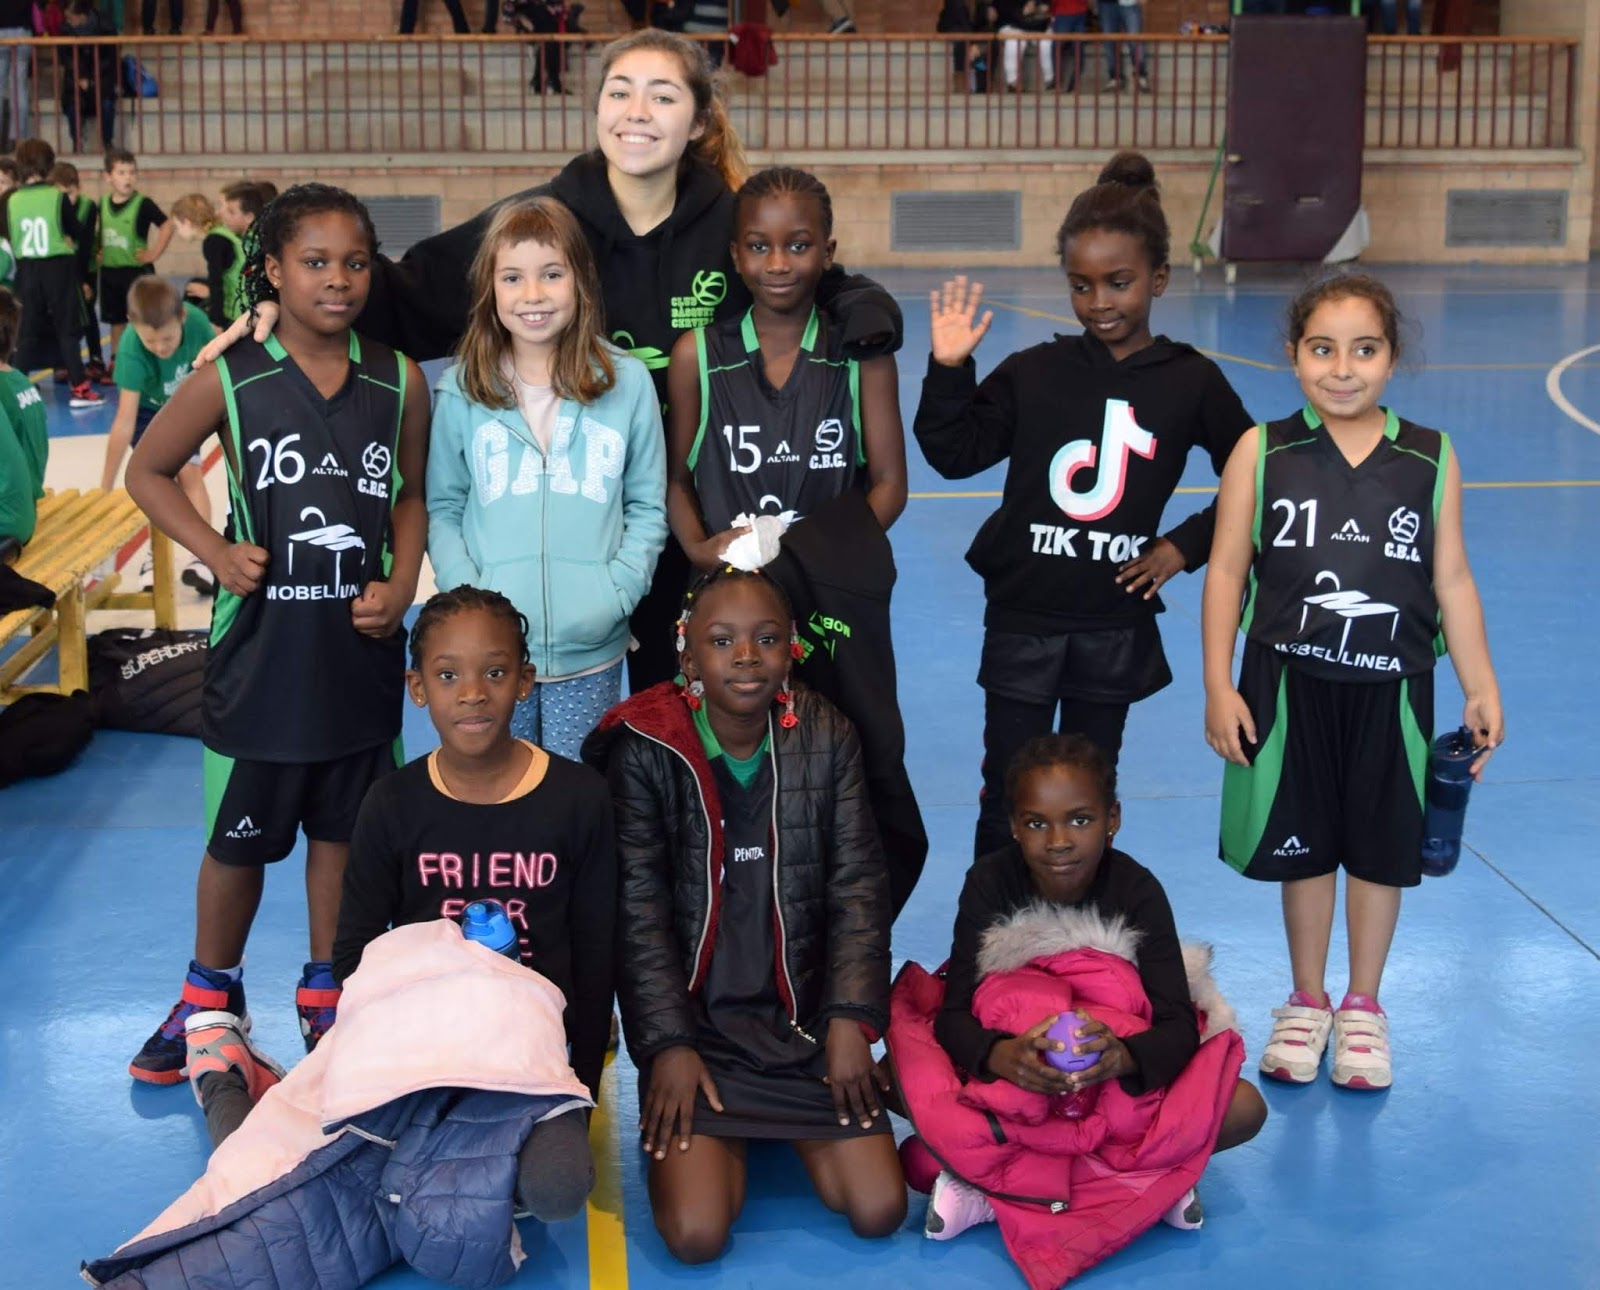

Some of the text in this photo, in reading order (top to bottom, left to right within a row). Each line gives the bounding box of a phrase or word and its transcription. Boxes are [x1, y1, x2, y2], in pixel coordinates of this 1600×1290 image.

[20, 216, 48, 257] 20
[248, 433, 306, 490] 26
[472, 416, 626, 508] GAP
[723, 425, 762, 474] 15
[767, 454, 800, 463] ALTAN
[809, 453, 847, 470] C.B.C.
[312, 467, 349, 478] ALTAN
[1272, 498, 1318, 548] 21
[1330, 532, 1370, 544] ALTAN
[1029, 523, 1149, 564] TIK TOK
[225, 829, 261, 838] ALTAN
[1272, 846, 1310, 857] ALTAN
[418, 851, 557, 889] FRIEND
[440, 898, 529, 930] FR
